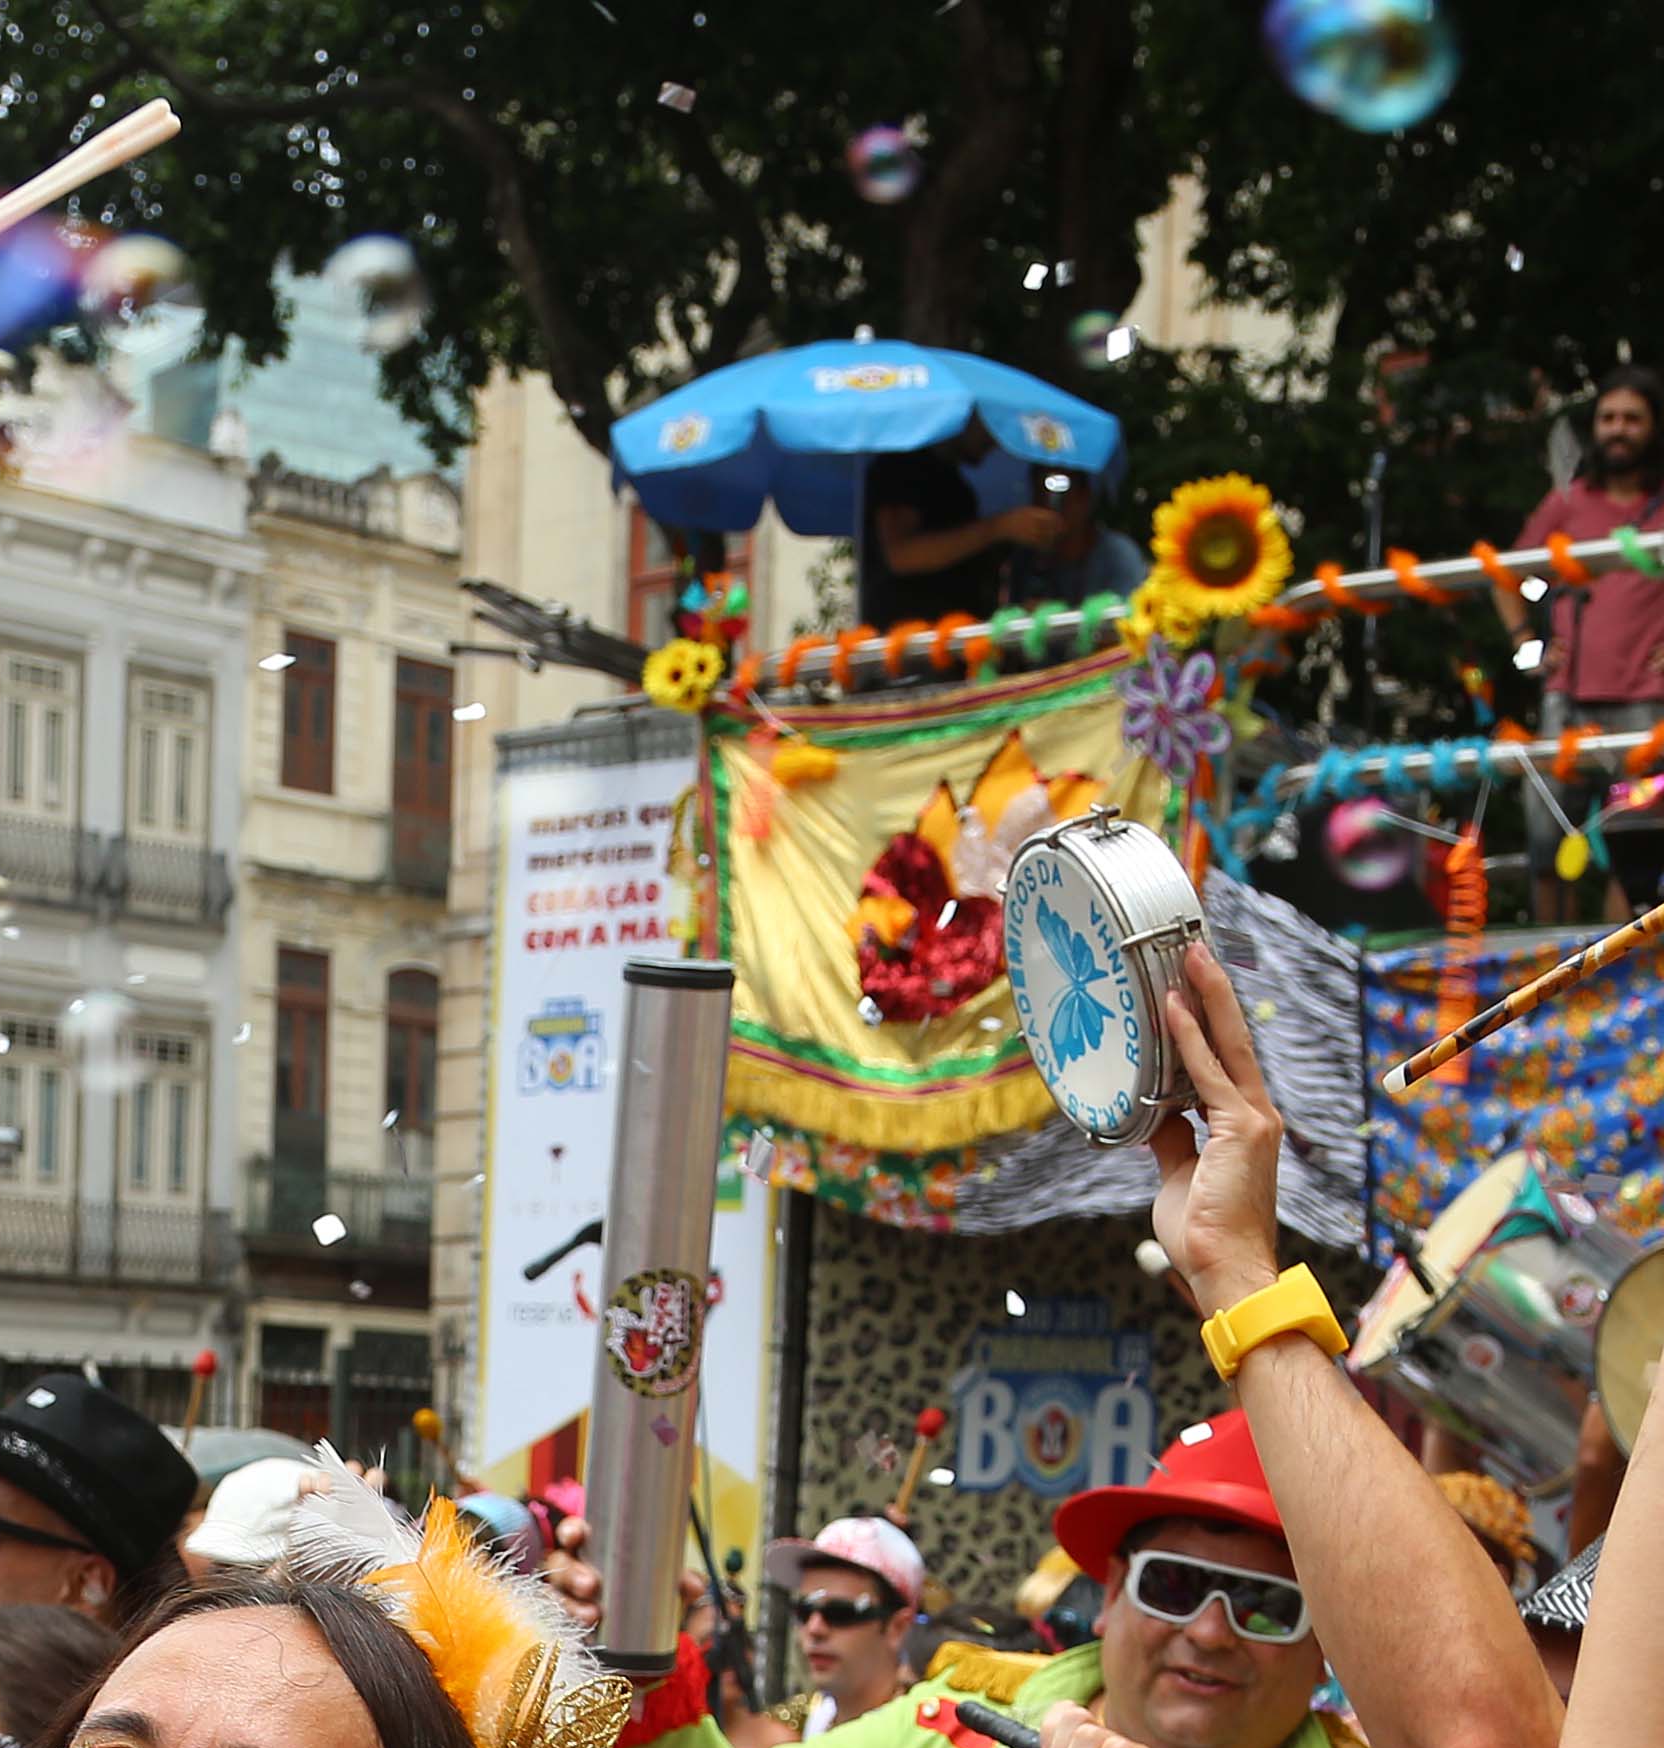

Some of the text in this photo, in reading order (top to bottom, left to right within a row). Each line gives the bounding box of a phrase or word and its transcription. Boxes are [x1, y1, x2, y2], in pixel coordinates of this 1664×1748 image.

[638, 804, 672, 827] qu
[524, 928, 580, 951] COM
[590, 923, 606, 943] A
[1036, 858, 1064, 888] DA
[1090, 900, 1140, 1068] ROCINHA
